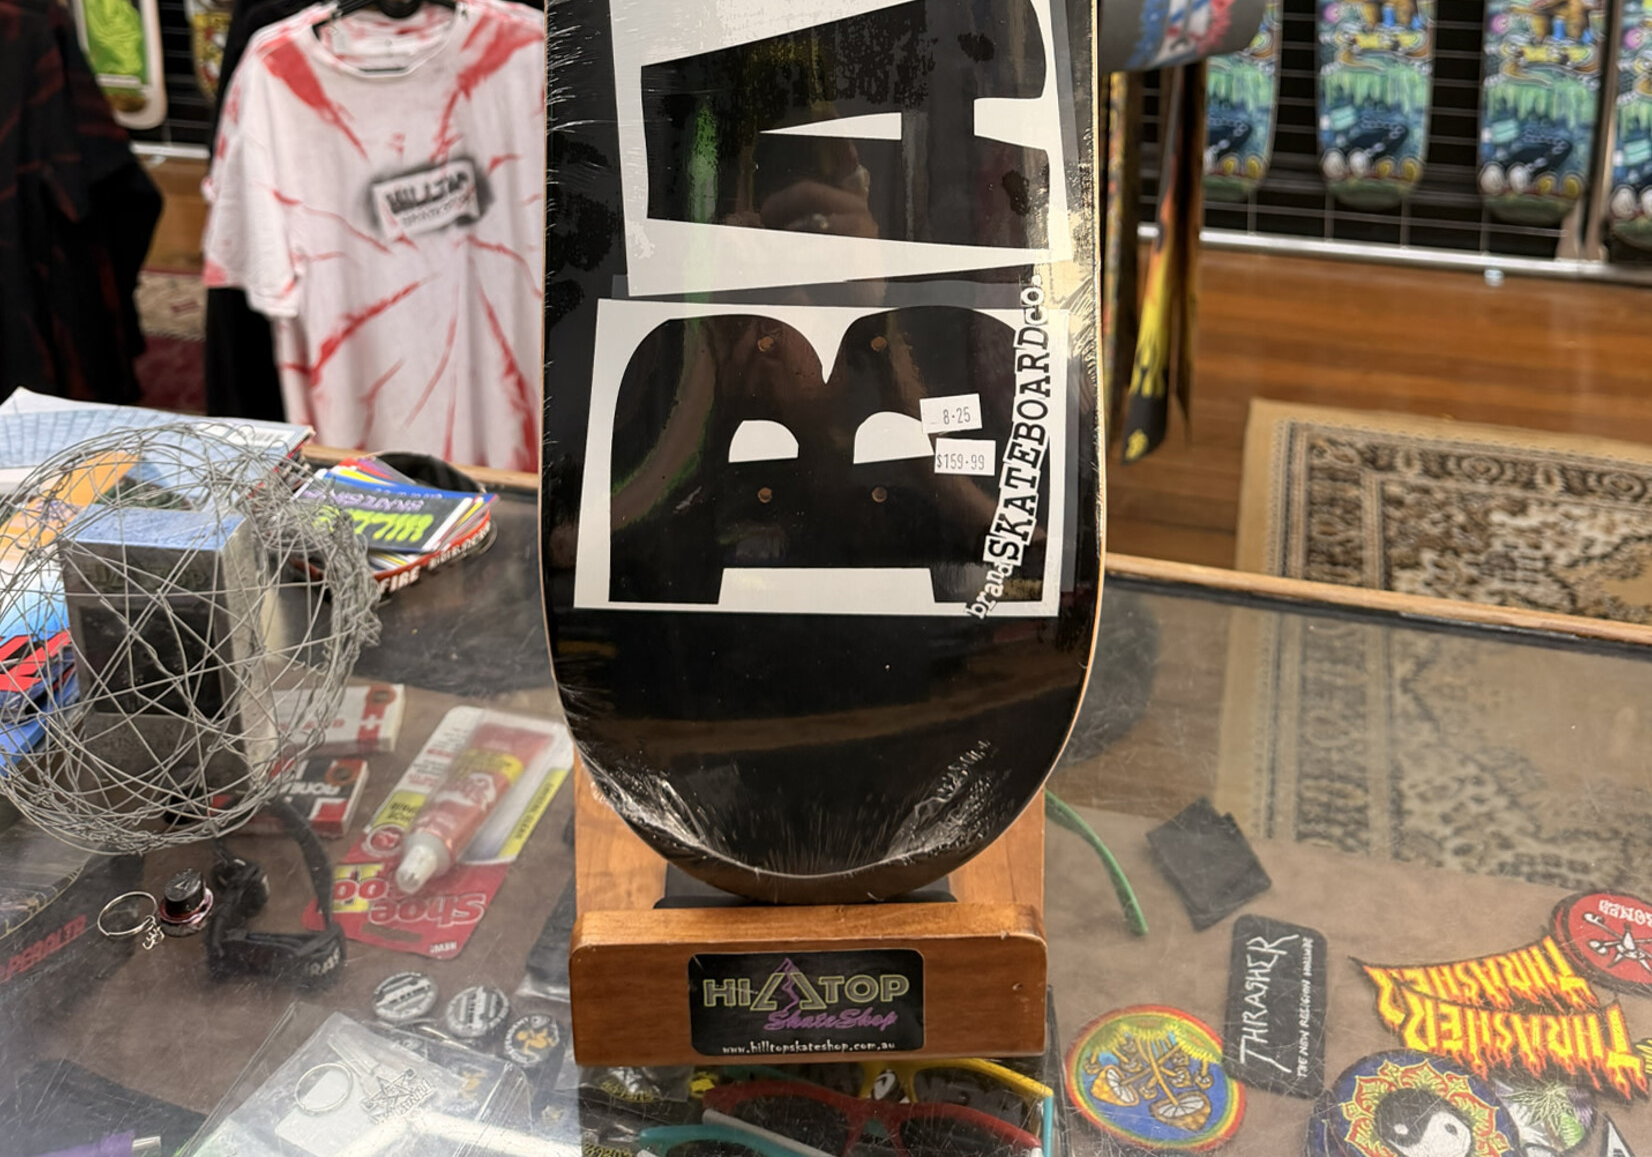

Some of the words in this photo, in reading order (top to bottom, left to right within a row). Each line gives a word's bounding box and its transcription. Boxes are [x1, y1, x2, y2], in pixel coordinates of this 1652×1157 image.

[368, 891, 487, 928] Shoe
[429, 940, 458, 954] NEW!
[1239, 933, 1300, 1074] THRASHER
[722, 1038, 896, 1055] www.hilltopskateshop.com.au
[1400, 990, 1647, 1099] THRASHER
